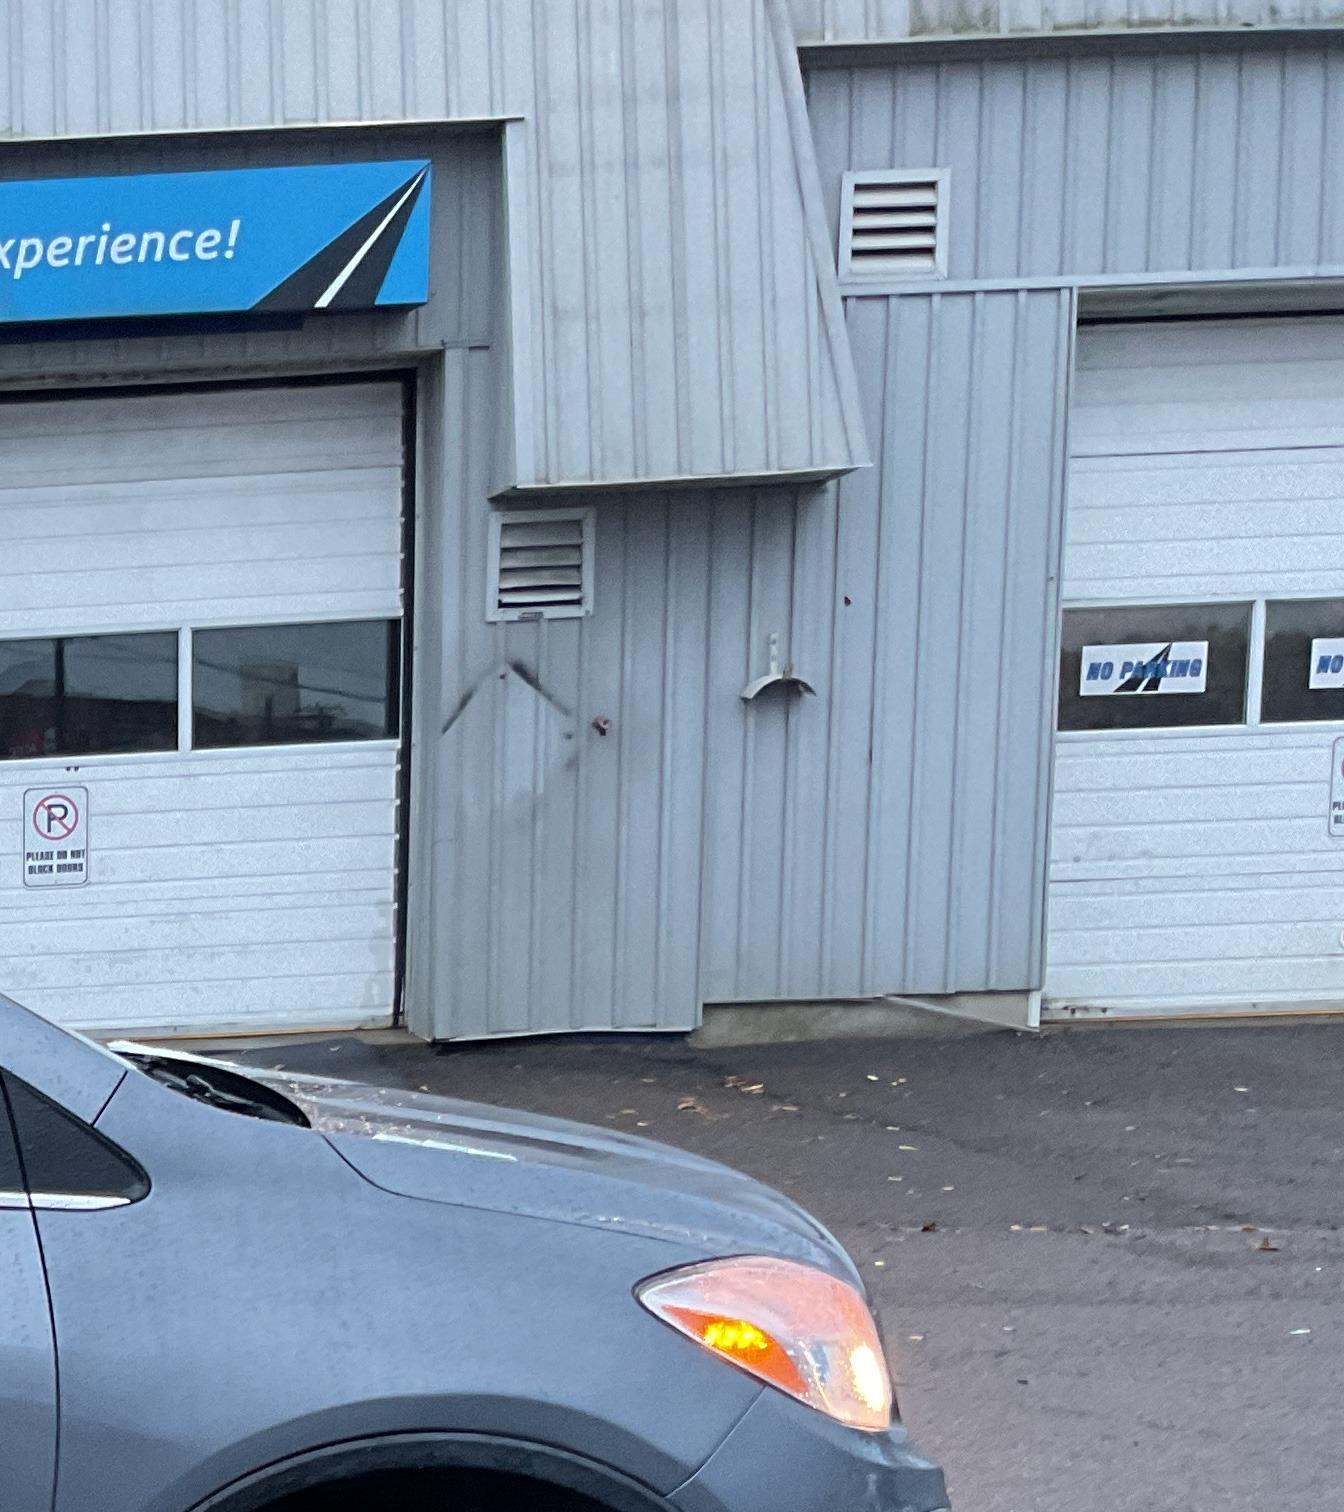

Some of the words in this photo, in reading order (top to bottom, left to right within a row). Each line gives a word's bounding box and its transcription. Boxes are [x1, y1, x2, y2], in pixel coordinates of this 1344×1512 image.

[1086, 661, 1114, 680] NO
[1119, 658, 1203, 680] PARKING
[1316, 654, 1344, 674] NO
[26, 851, 54, 861] PLEASE
[28, 864, 53, 875] BLOCK
[56, 863, 83, 873] DOORS
